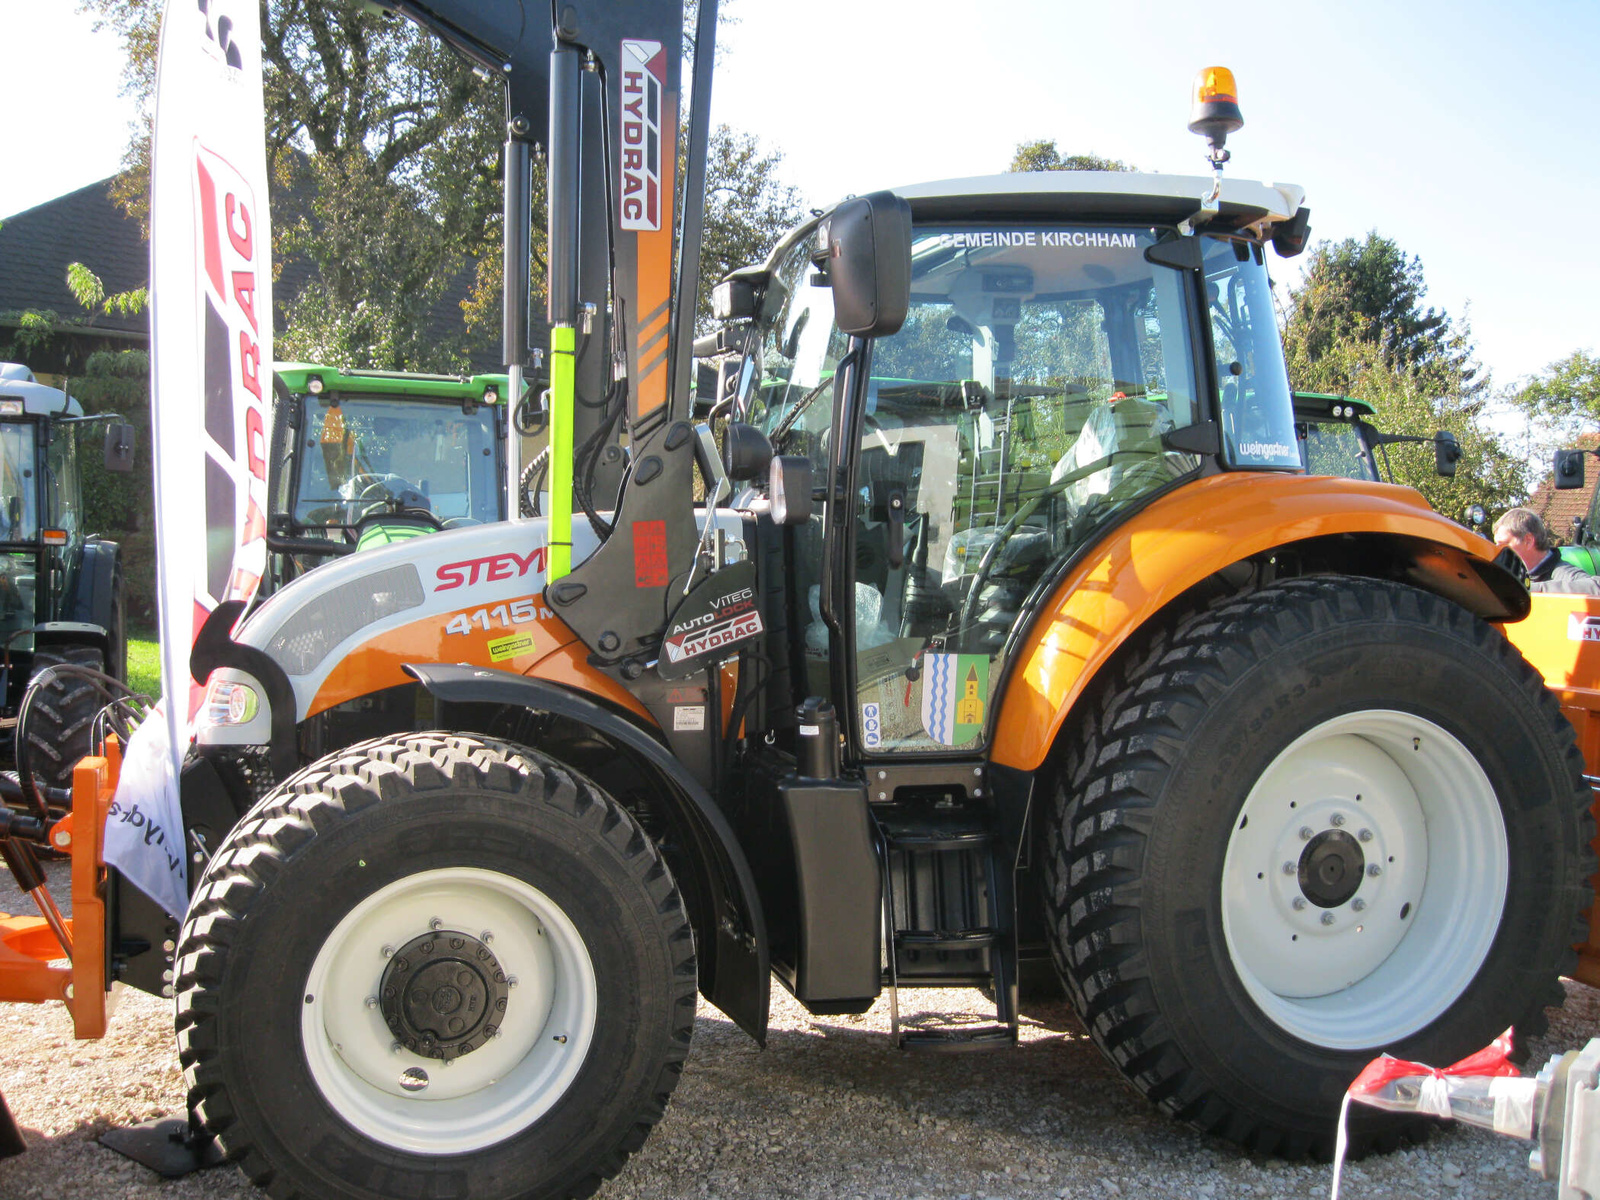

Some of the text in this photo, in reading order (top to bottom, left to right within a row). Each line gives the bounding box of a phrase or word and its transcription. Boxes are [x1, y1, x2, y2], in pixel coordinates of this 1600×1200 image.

[623, 71, 643, 220] HYDRAC
[939, 232, 1136, 248] GEMEINDE KIRCHHAM
[445, 598, 538, 636] 4115
[684, 621, 758, 656] HYDRAC
